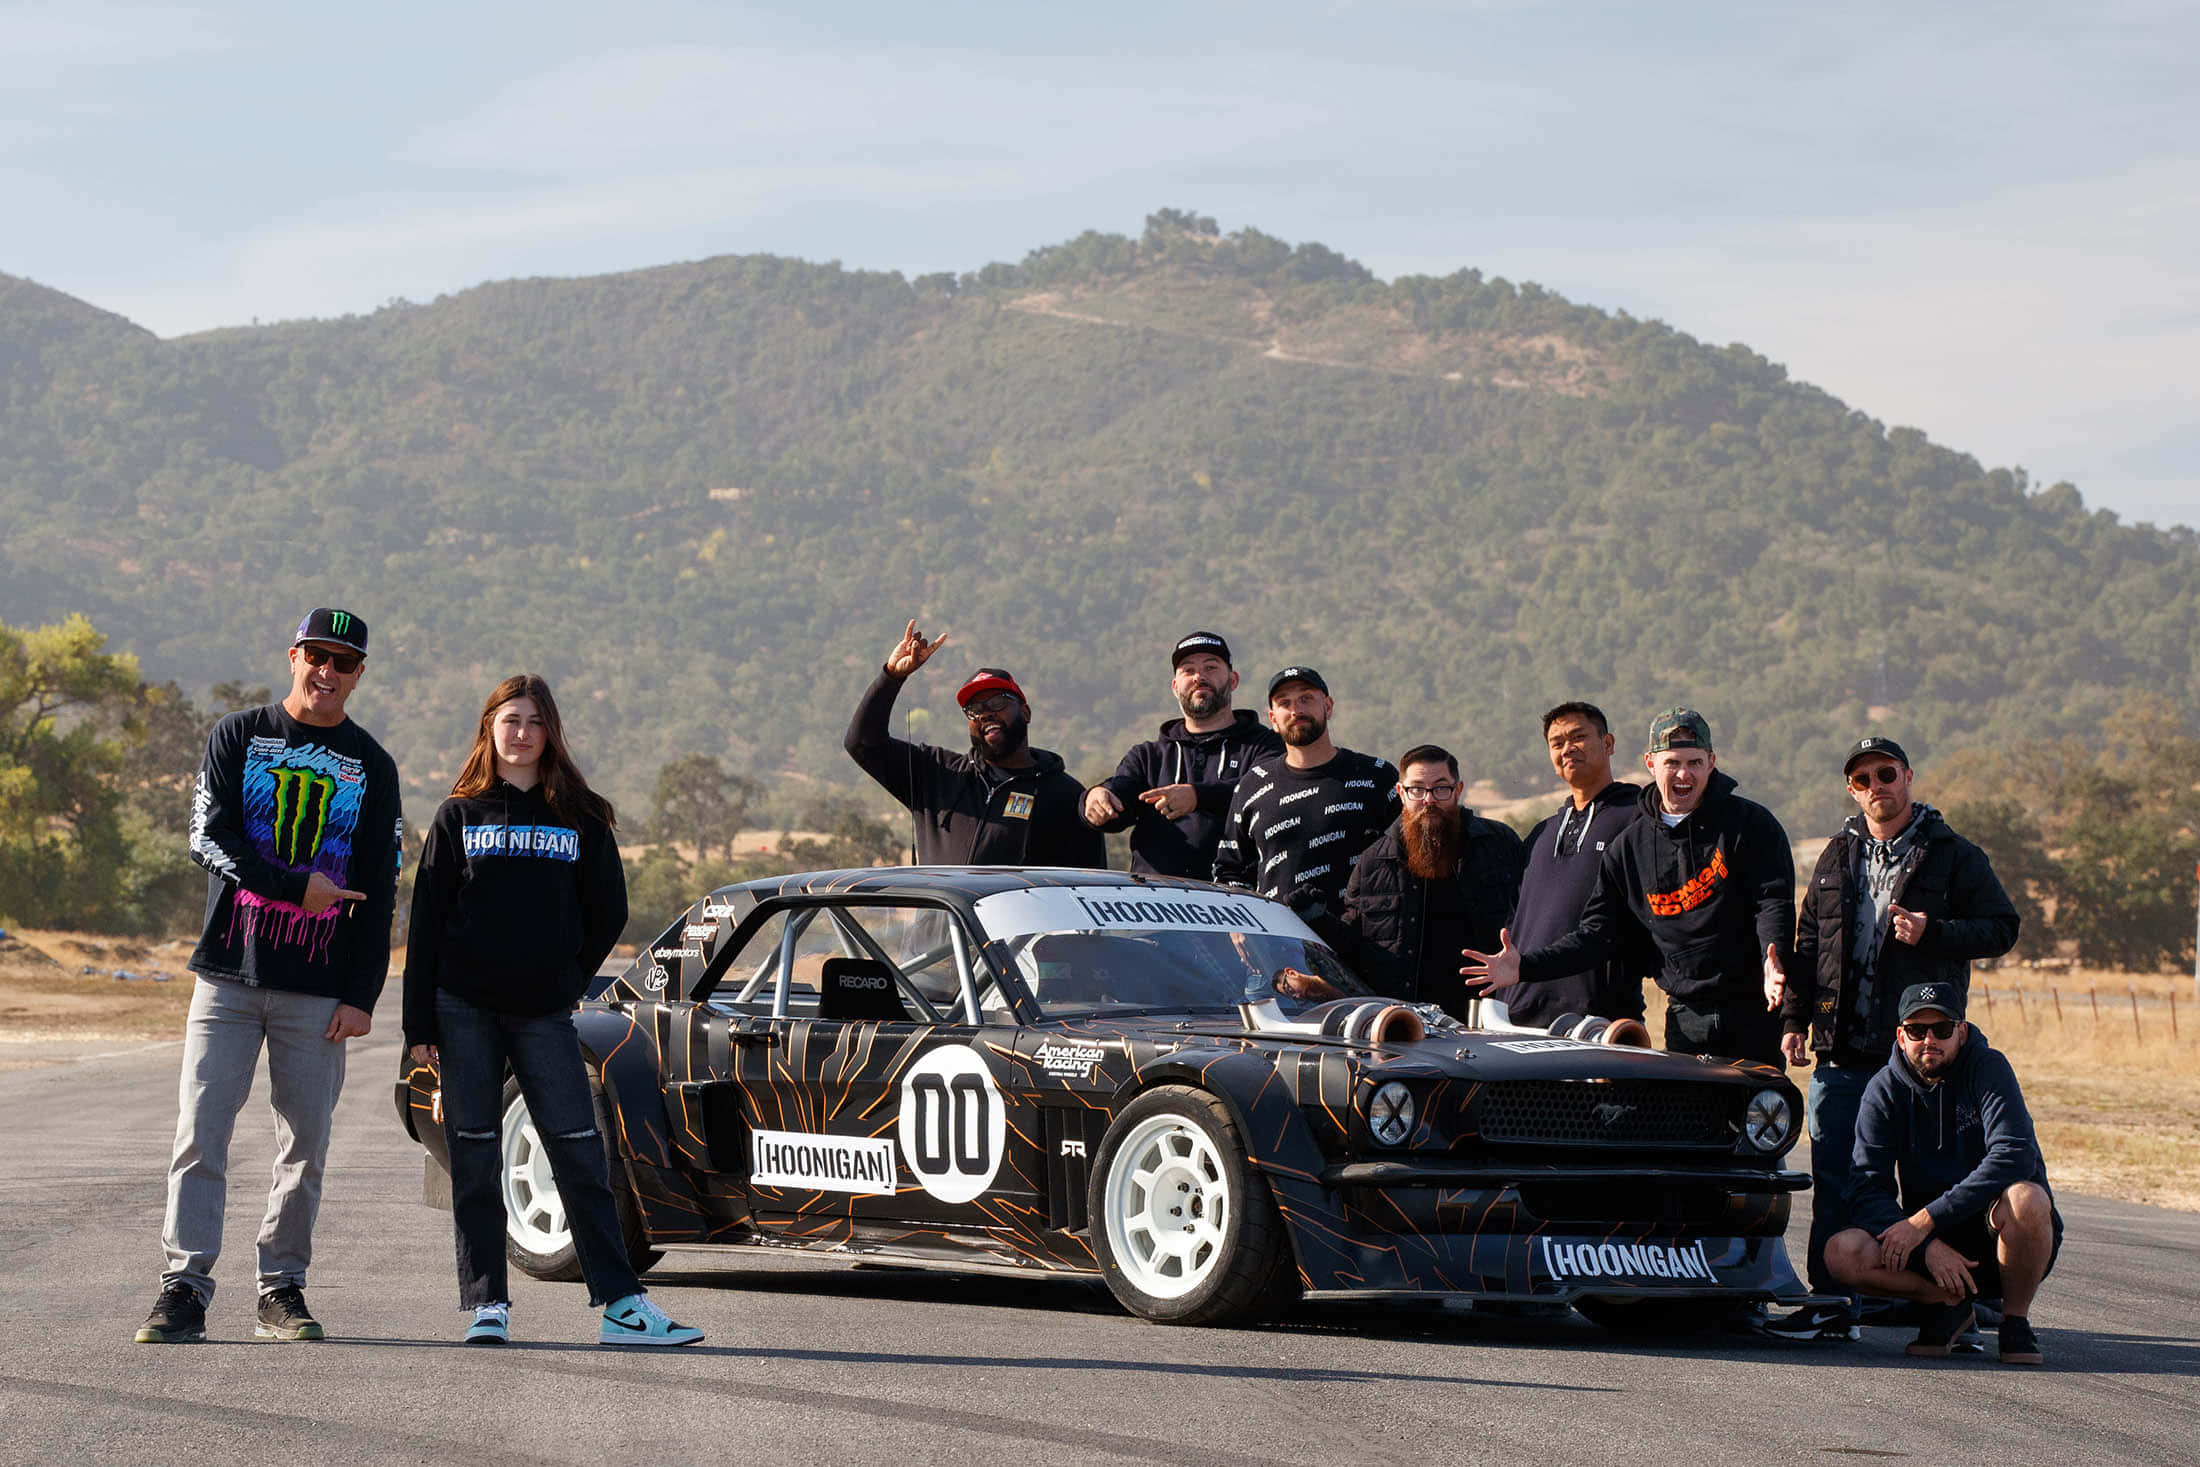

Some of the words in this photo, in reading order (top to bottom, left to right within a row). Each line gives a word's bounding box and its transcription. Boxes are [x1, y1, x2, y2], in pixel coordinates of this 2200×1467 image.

[1279, 786, 1320, 806] HOONIGAN
[1324, 801, 1364, 815] HOONIGAN
[1308, 830, 1346, 849] HOONIGAN
[839, 974, 888, 990] RECARO
[1033, 1039, 1105, 1060] American
[1043, 1059, 1094, 1078] Racing
[911, 1073, 990, 1175] 00
